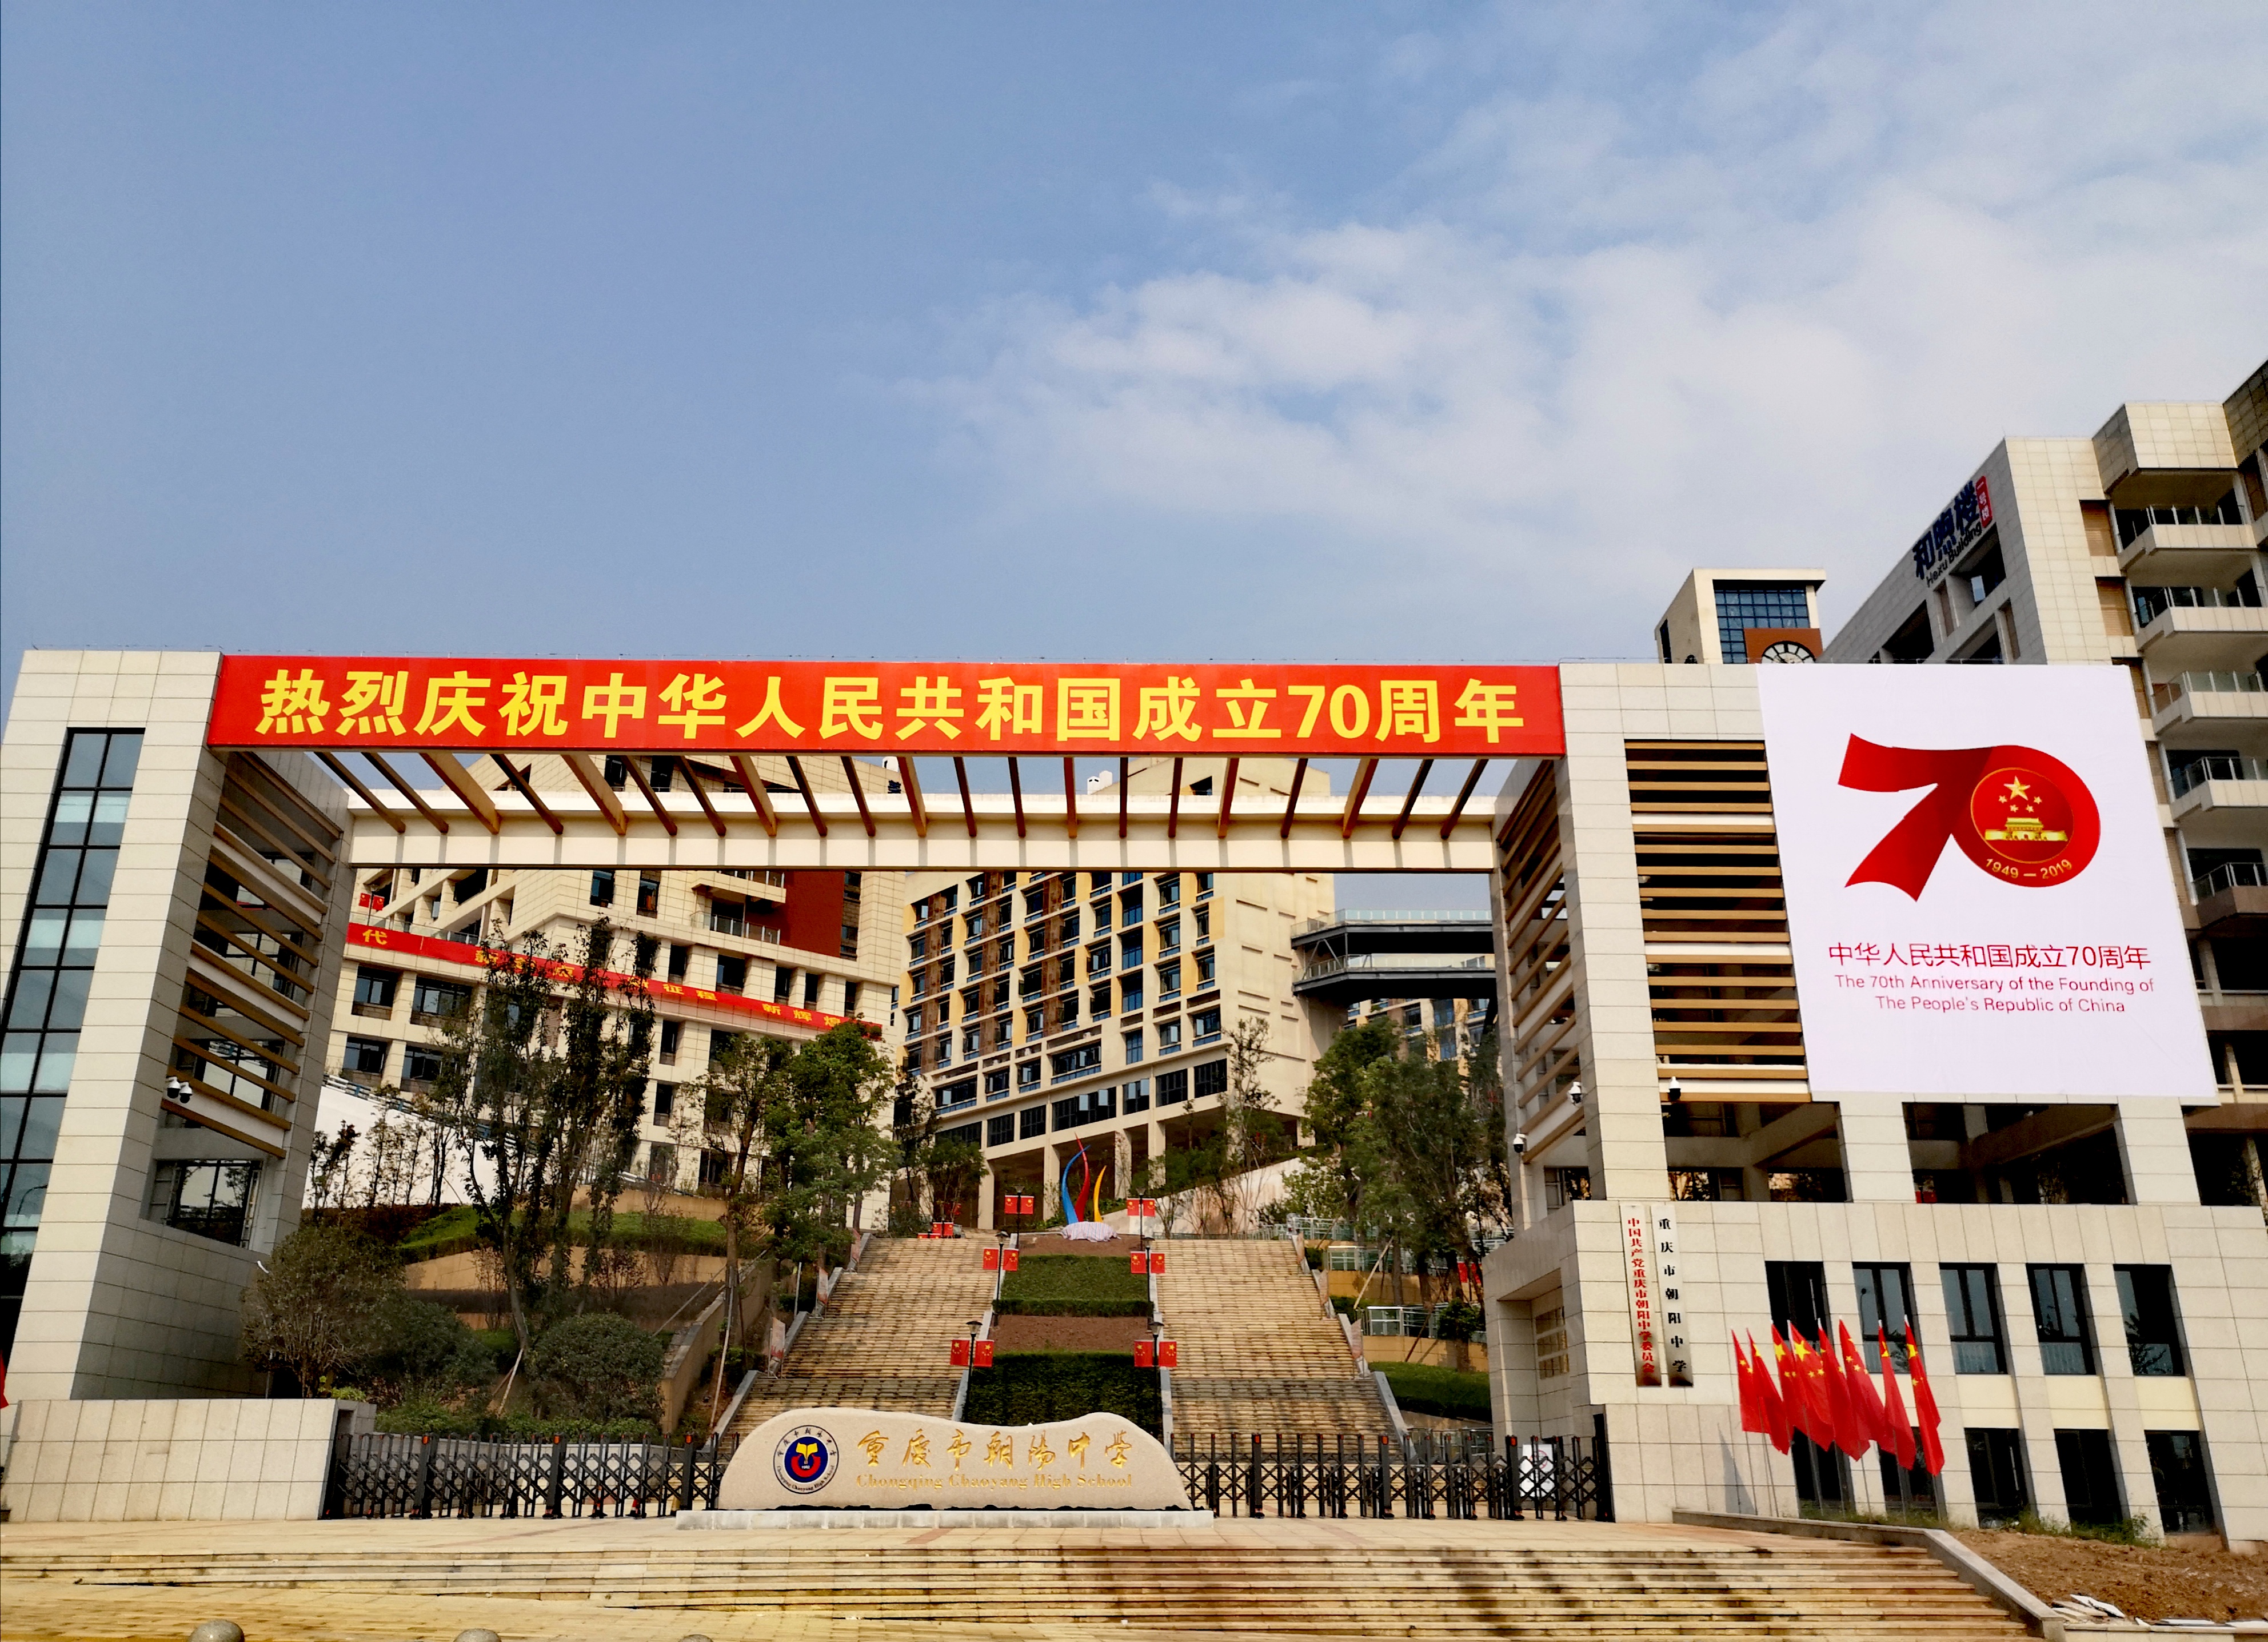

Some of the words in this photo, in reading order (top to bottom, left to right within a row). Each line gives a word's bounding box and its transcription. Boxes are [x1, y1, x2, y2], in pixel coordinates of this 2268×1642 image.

[1926, 561, 1948, 587] Hexu
[1947, 521, 1983, 564] Building
[255, 669, 1524, 743] 热烈庆祝中华人民共和国成立70周年
[1828, 942, 2151, 970] 中华人民共和国成立70周年
[1835, 974, 1864, 988] The
[1870, 975, 1904, 988] 70th
[1911, 975, 2003, 993] Anniversary
[2009, 977, 2023, 990] of
[2029, 977, 2054, 990] the
[2059, 978, 2135, 995] Founding
[2139, 978, 2154, 992] of
[1875, 995, 1906, 1009] The
[1911, 996, 1979, 1013] People's
[1983, 998, 2054, 1014] Republic
[2059, 998, 2073, 1011] of
[2078, 998, 2125, 1012] China
[1628, 1218, 1655, 1373] 中国共产党重庆市朝阳中学委员会
[1658, 1218, 1687, 1373] 重庆市朝阳中学
[856, 1474, 943, 1490] Chongqing
[949, 1474, 1028, 1490] Chaoyang
[1033, 1473, 1071, 1490] High
[1077, 1474, 1132, 1488] School
